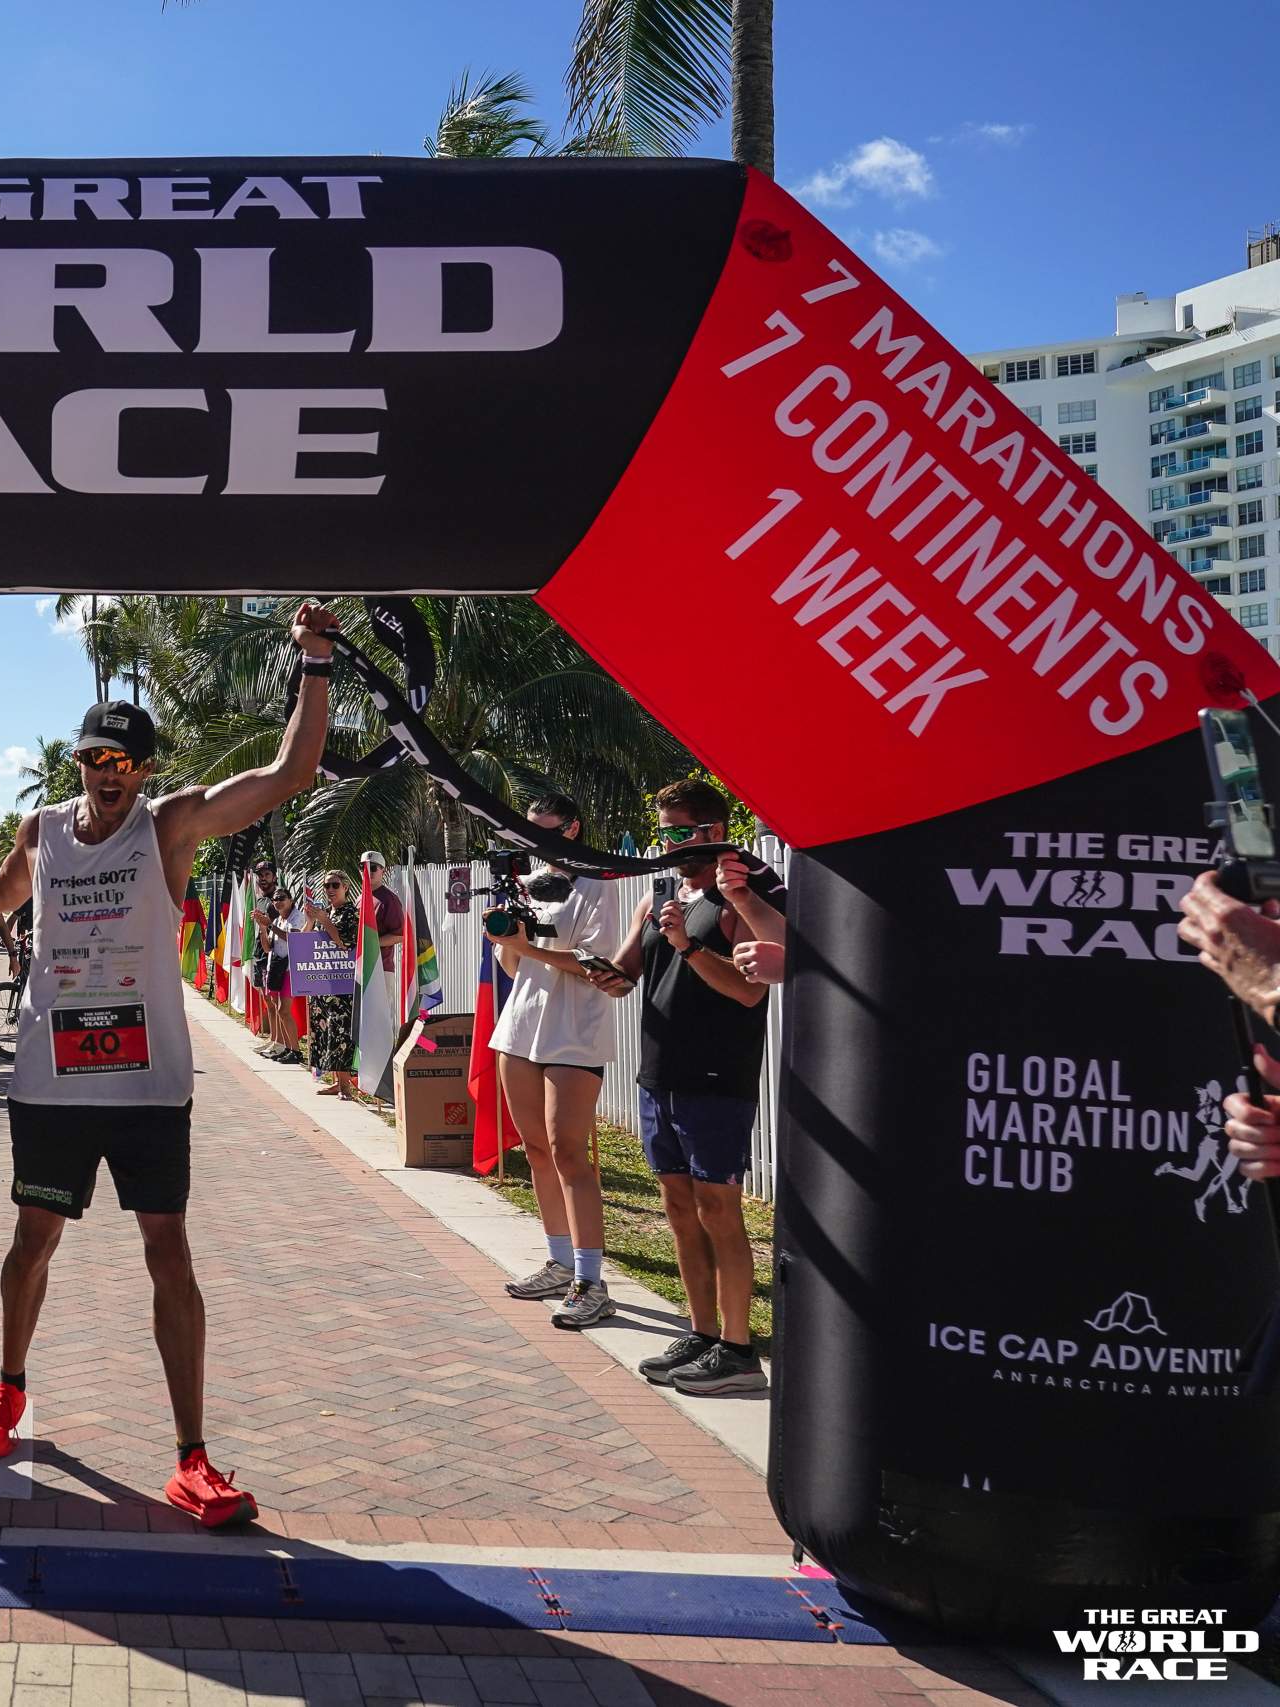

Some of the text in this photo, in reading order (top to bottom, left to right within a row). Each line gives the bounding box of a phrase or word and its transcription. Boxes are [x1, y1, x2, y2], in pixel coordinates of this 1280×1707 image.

[801, 259, 1213, 655] 7 MARATHONS
[720, 310, 1168, 736] 7 CONTINENTS
[725, 489, 989, 738] 1 WEEK
[1004, 832, 1226, 864] THE GRE
[50, 868, 137, 889] Project 5077
[945, 869, 1194, 911] WOR
[62, 889, 124, 906] Live it Up
[58, 910, 93, 922] WEST
[94, 906, 132, 918] COAST
[313, 940, 342, 949] LAS
[999, 917, 1205, 962] RAC
[296, 960, 355, 971] MARATHO
[313, 950, 349, 960] DAMN
[78, 1014, 118, 1022] WORLD
[79, 1031, 120, 1056] 40
[409, 1068, 460, 1077] EXTRA LARGE
[968, 1053, 1131, 1102] GLOBAL
[967, 1098, 1189, 1153] MARATHON
[965, 1145, 1073, 1193] CLUB
[929, 1323, 1241, 1374] ICE CAP ADVENTU
[993, 1370, 1240, 1396] ANTARCTICA AWAITS
